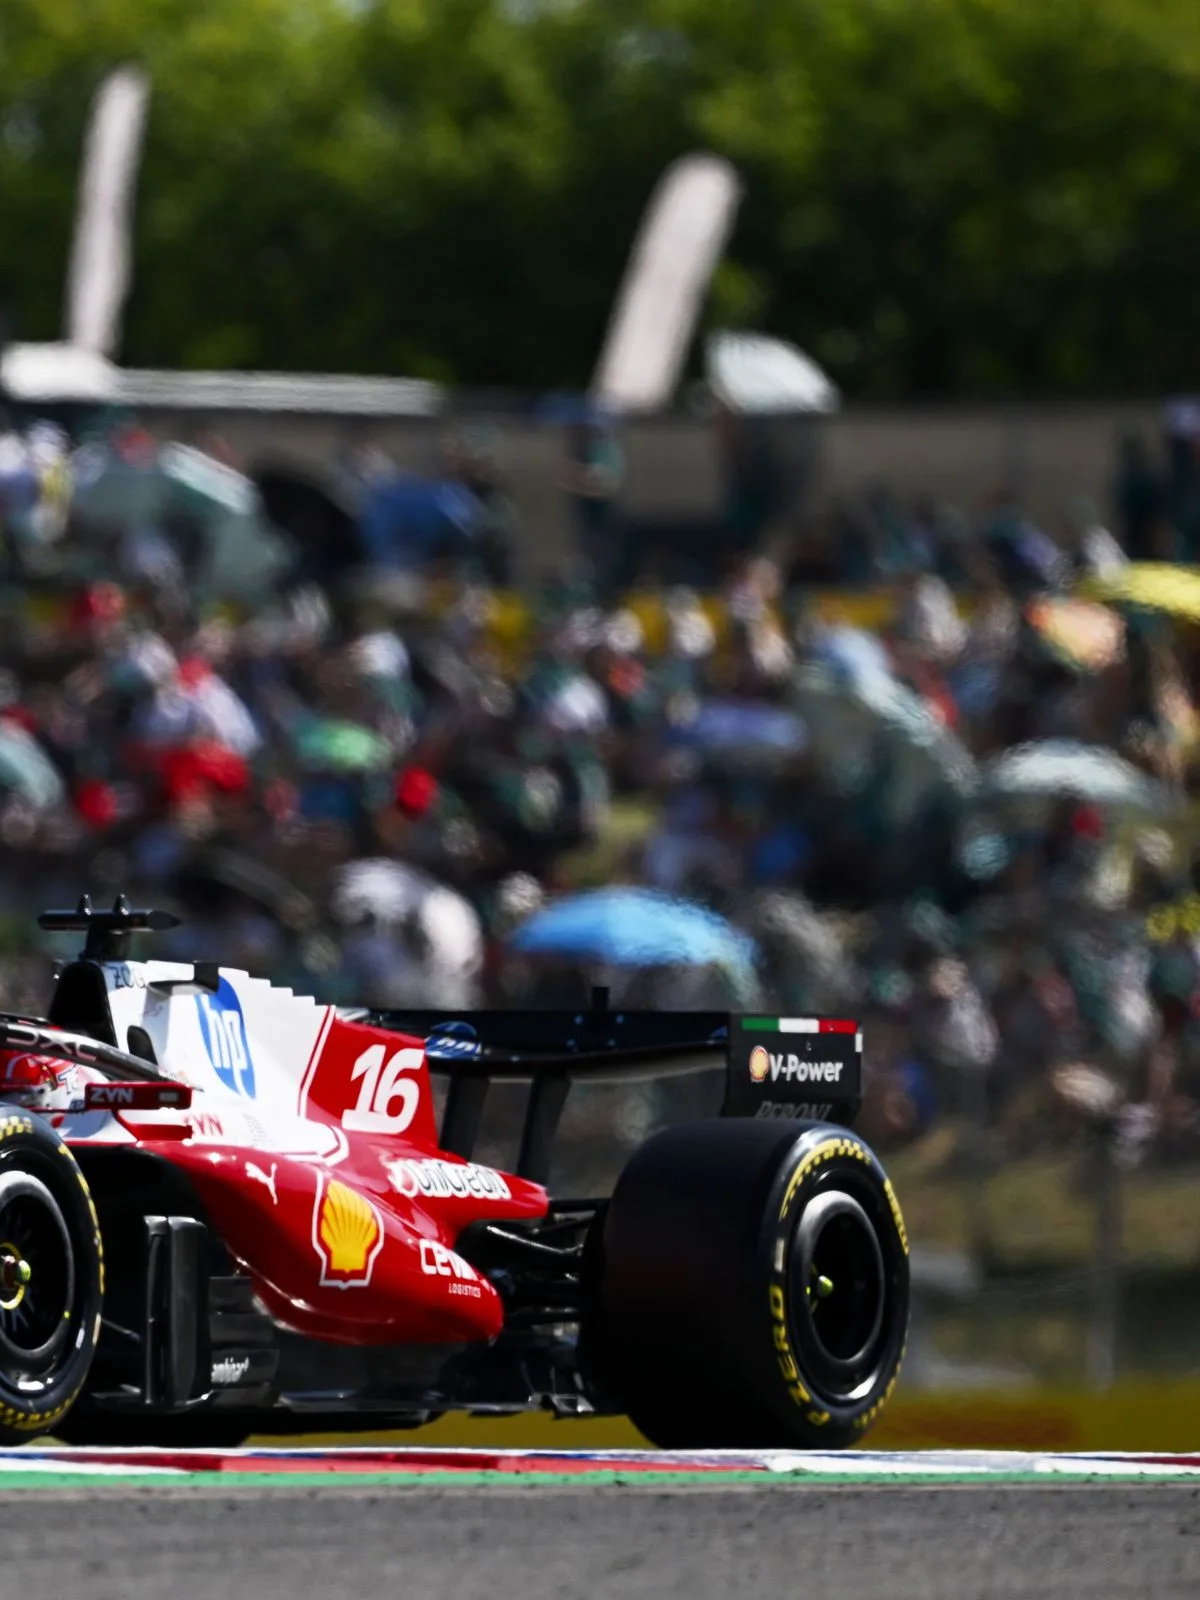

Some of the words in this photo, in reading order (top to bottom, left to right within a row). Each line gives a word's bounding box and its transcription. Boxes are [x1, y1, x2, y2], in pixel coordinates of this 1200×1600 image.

[199, 992, 249, 1099] hp
[769, 1053, 844, 1083] V-Power
[90, 1087, 134, 1103] ZYN
[341, 1043, 426, 1135] 16
[448, 1282, 481, 1299] LOGISTICS
[769, 1284, 811, 1406] ZERO
